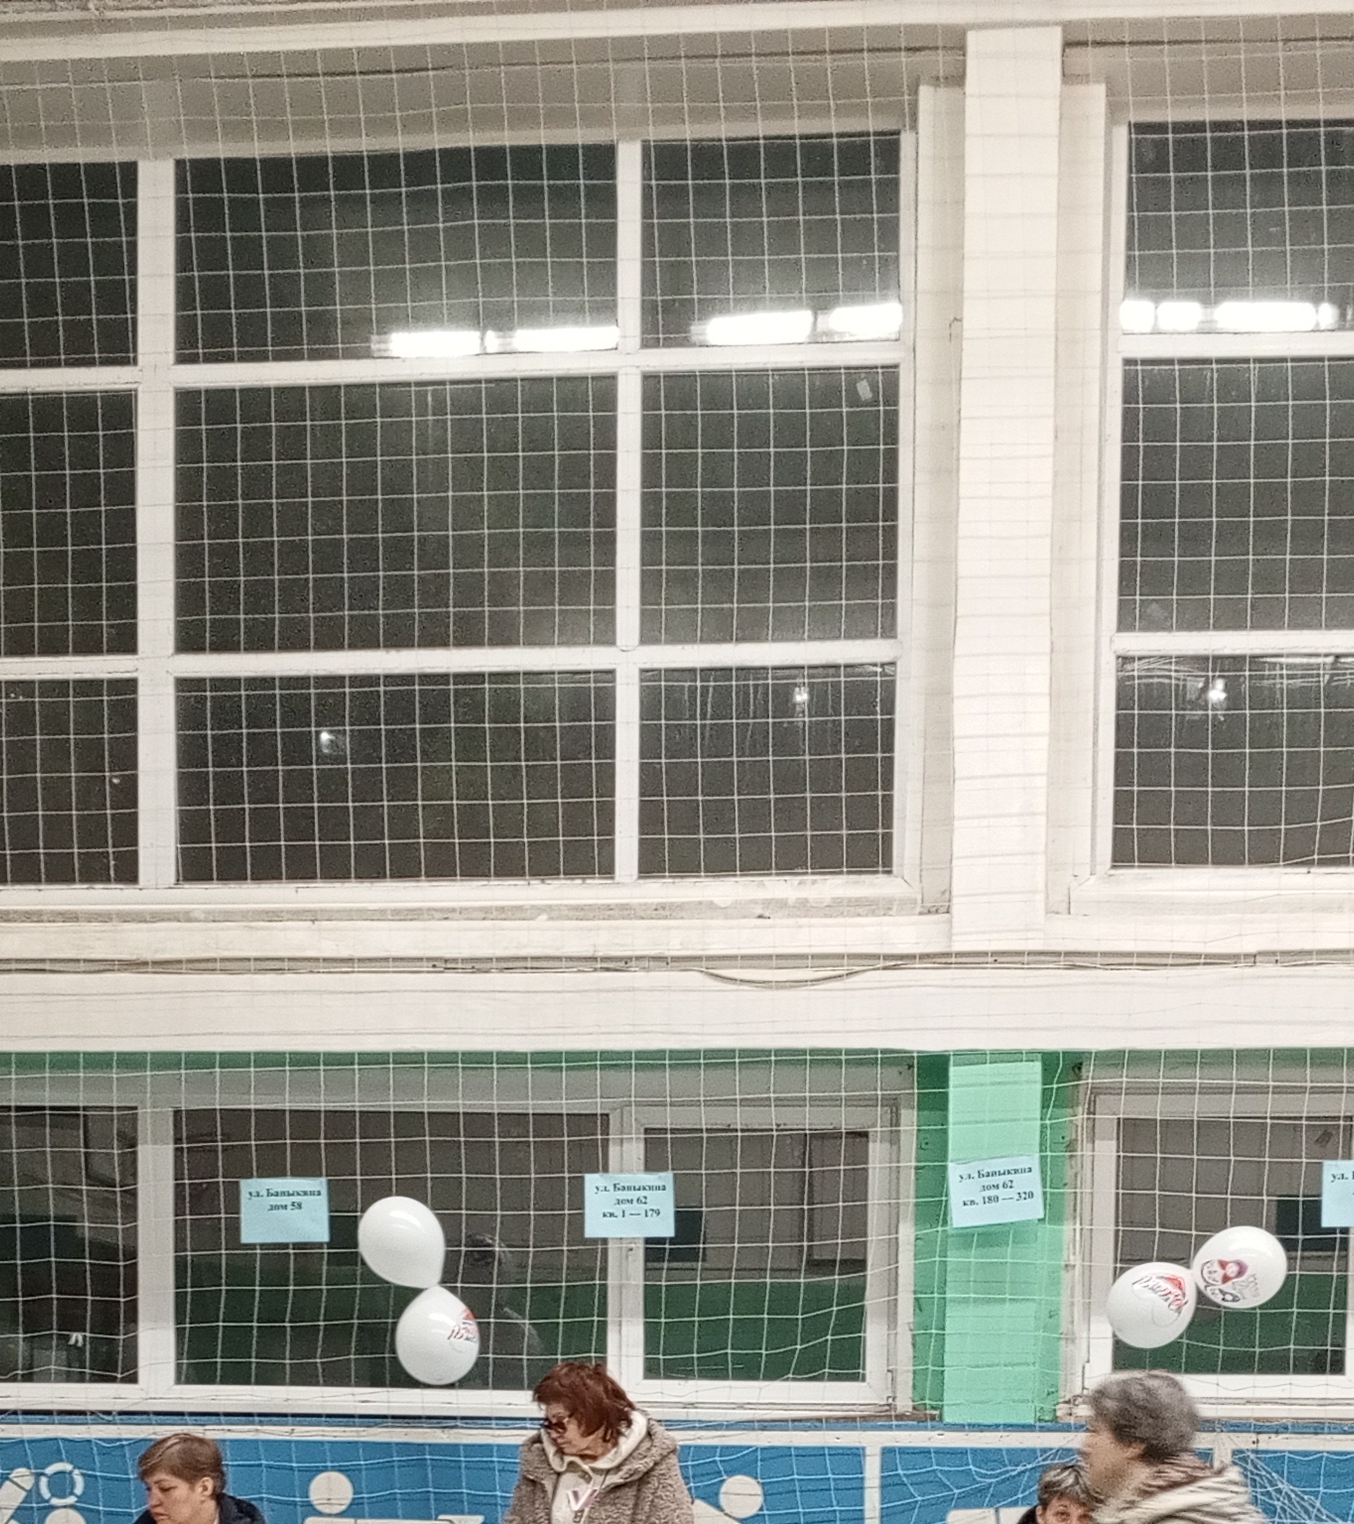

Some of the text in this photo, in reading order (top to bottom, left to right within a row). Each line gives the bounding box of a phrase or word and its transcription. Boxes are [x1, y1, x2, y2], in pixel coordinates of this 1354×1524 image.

[958, 1166, 1033, 1183] ул. Баныкина
[1331, 1172, 1349, 1183] ул.
[595, 1183, 666, 1194] ул. Баныкина
[979, 1179, 1015, 1193] дом 62
[248, 1188, 322, 1200] ул. Баныкина
[962, 1199, 979, 1207] кв.
[982, 1194, 1000, 1205] 180
[1015, 1190, 1035, 1201] 320
[267, 1201, 303, 1211] дом 58
[613, 1196, 648, 1206] дом 62
[644, 1208, 661, 1218] 179
